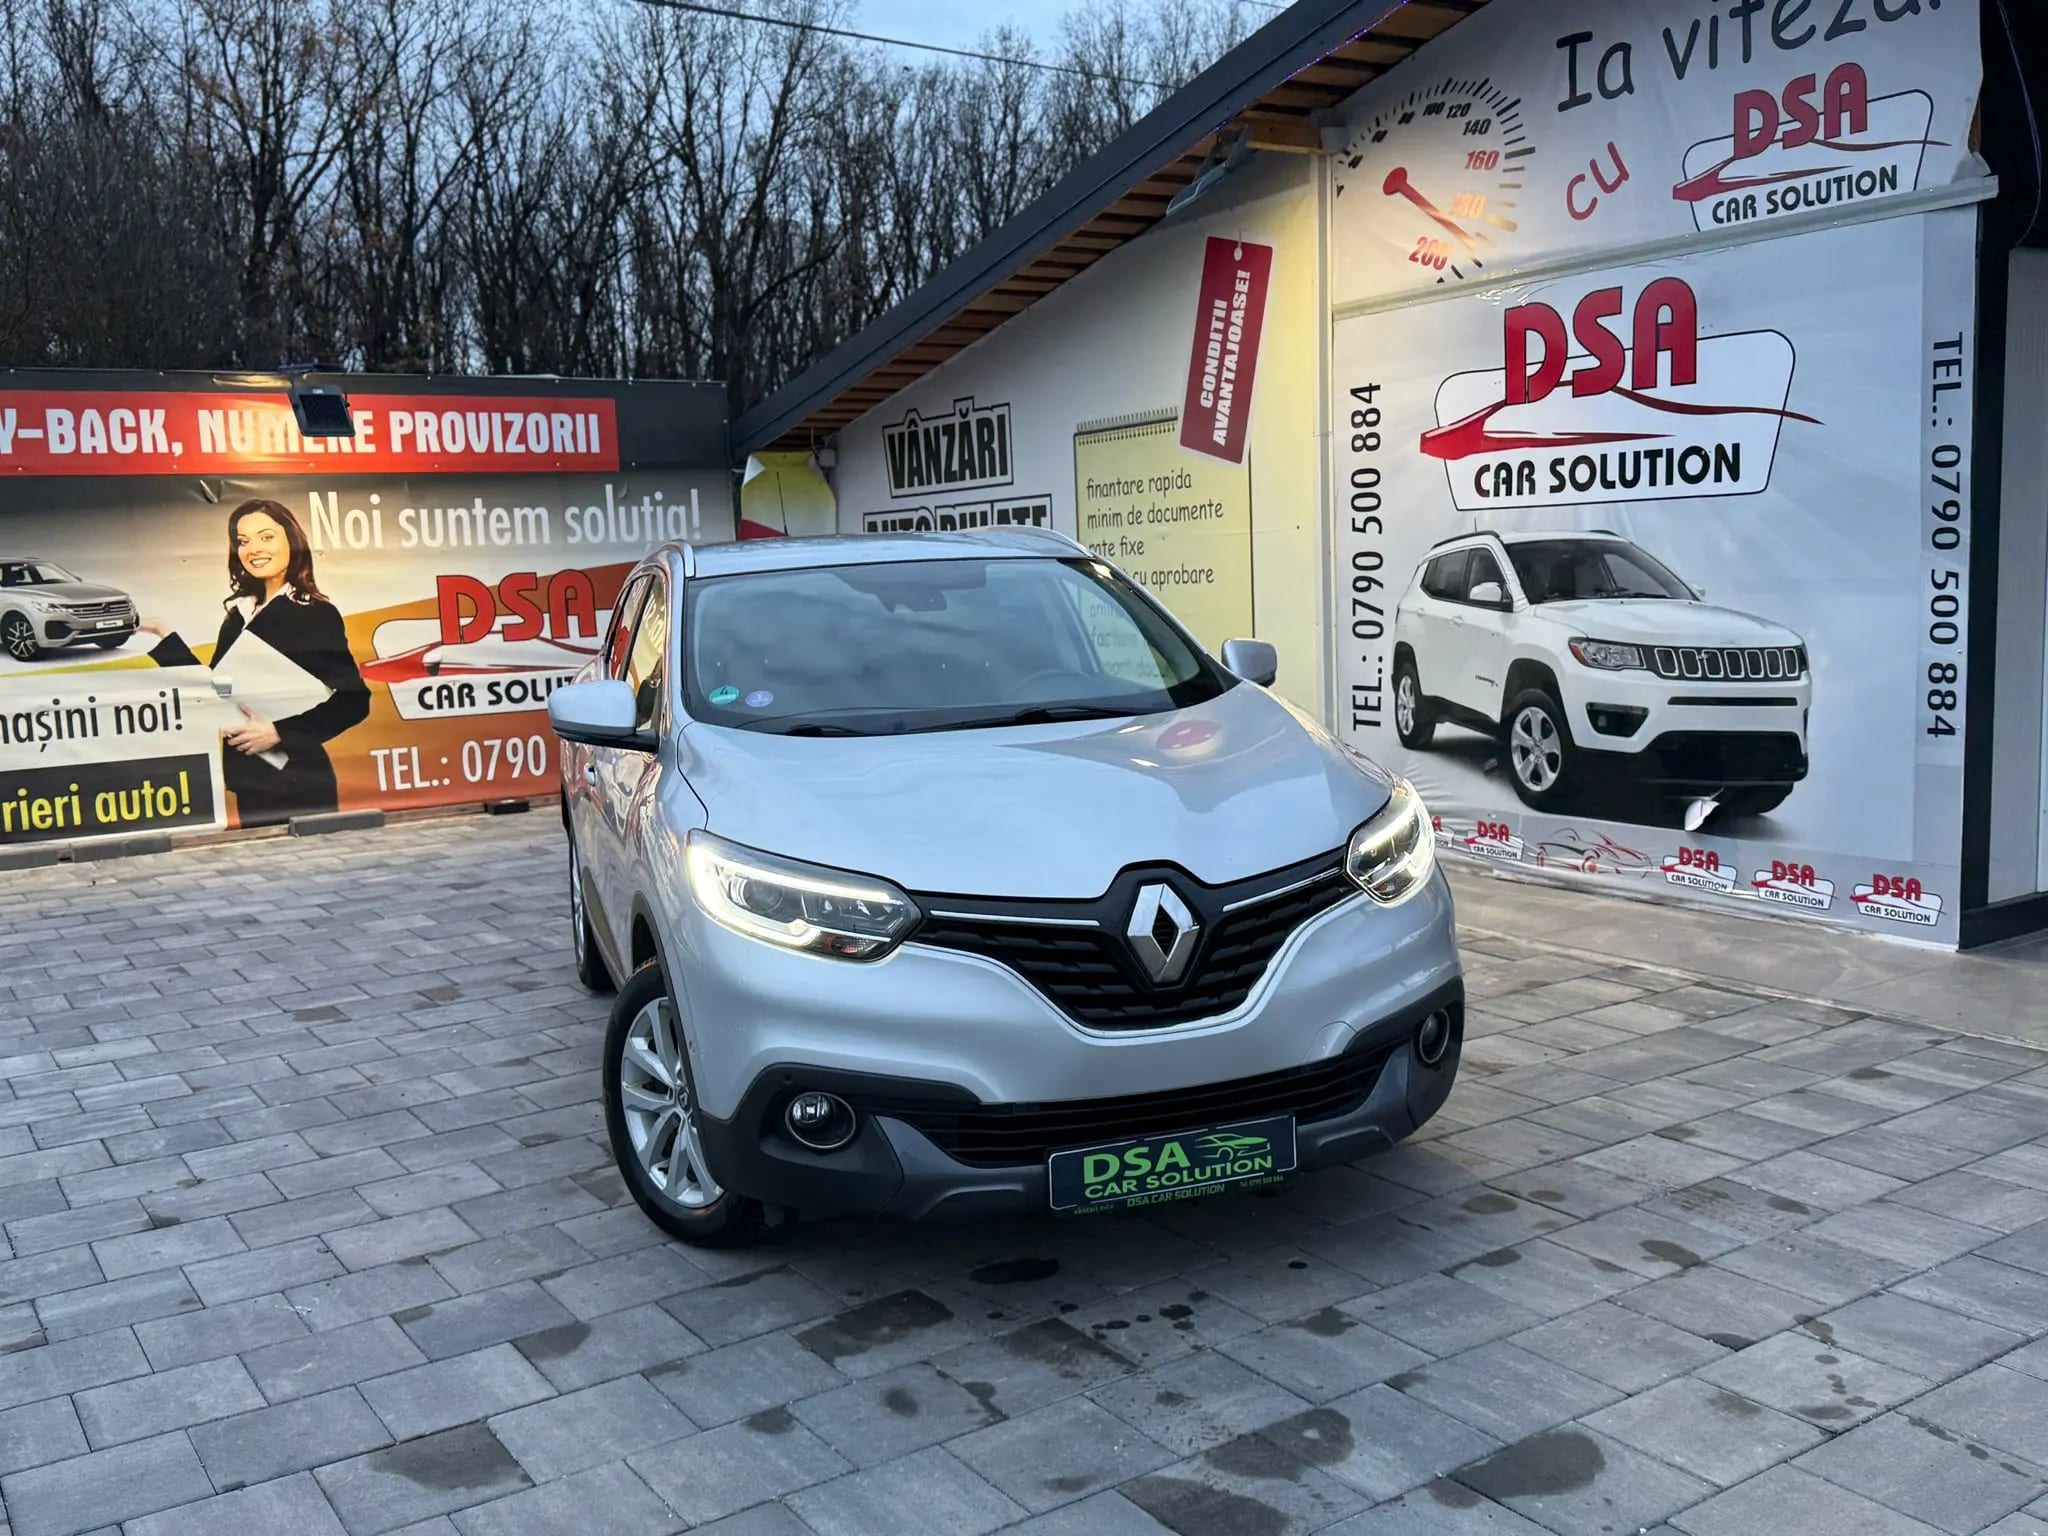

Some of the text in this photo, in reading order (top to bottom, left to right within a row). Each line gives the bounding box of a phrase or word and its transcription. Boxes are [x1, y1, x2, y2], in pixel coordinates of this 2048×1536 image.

[1555, 31, 1636, 113] Ia
[1446, 102, 1472, 119] 120
[1462, 118, 1492, 136] 140
[1733, 62, 1868, 160] DSA
[1465, 150, 1500, 170] 160
[1566, 141, 1630, 221] cu
[1712, 165, 1898, 224] CAR SOLUTION
[1408, 236, 1452, 271] 200
[1200, 299, 1228, 408] CONDITII
[1212, 269, 1251, 447] AVANTAJOASE!
[1504, 276, 1697, 406] DSA
[388, 410, 600, 455] PROVIZORII
[887, 406, 1009, 490] VÂNZĂRI
[1086, 467, 1192, 500] finantare rapida
[1474, 442, 1741, 498] CAR SOLUTION
[308, 490, 384, 550] Noi
[399, 498, 551, 548] suntem
[1087, 498, 1224, 530] minim de documente
[1927, 331, 1963, 739] TEL.: 0790 500 884
[1119, 536, 1146, 558] fixe
[1349, 382, 1384, 732] TEL.: 0790 500 884
[1151, 563, 1215, 592] aprobare
[436, 568, 598, 645] DSA
[114, 687, 184, 736] noi!
[417, 683, 476, 711] CAR
[369, 734, 547, 793] TEL.: 0790
[2, 770, 192, 833] rieri auto!
[1476, 820, 1510, 842] DSA
[1485, 847, 1518, 859] SOLUTION
[1679, 846, 1719, 872] DSA
[1772, 860, 1815, 887] DSA
[1688, 876, 1728, 892] SOLUTION
[1783, 891, 1825, 907] SOLUTION
[1873, 874, 1921, 901] DSA
[1884, 907, 1931, 923] SOLUTION
[1083, 1141, 1191, 1184] DSA
[1084, 1179, 1138, 1199] CAR
[1146, 1155, 1273, 1189] SOLUTION
[1126, 1183, 1225, 1208] DSA CAR SOLUTION
